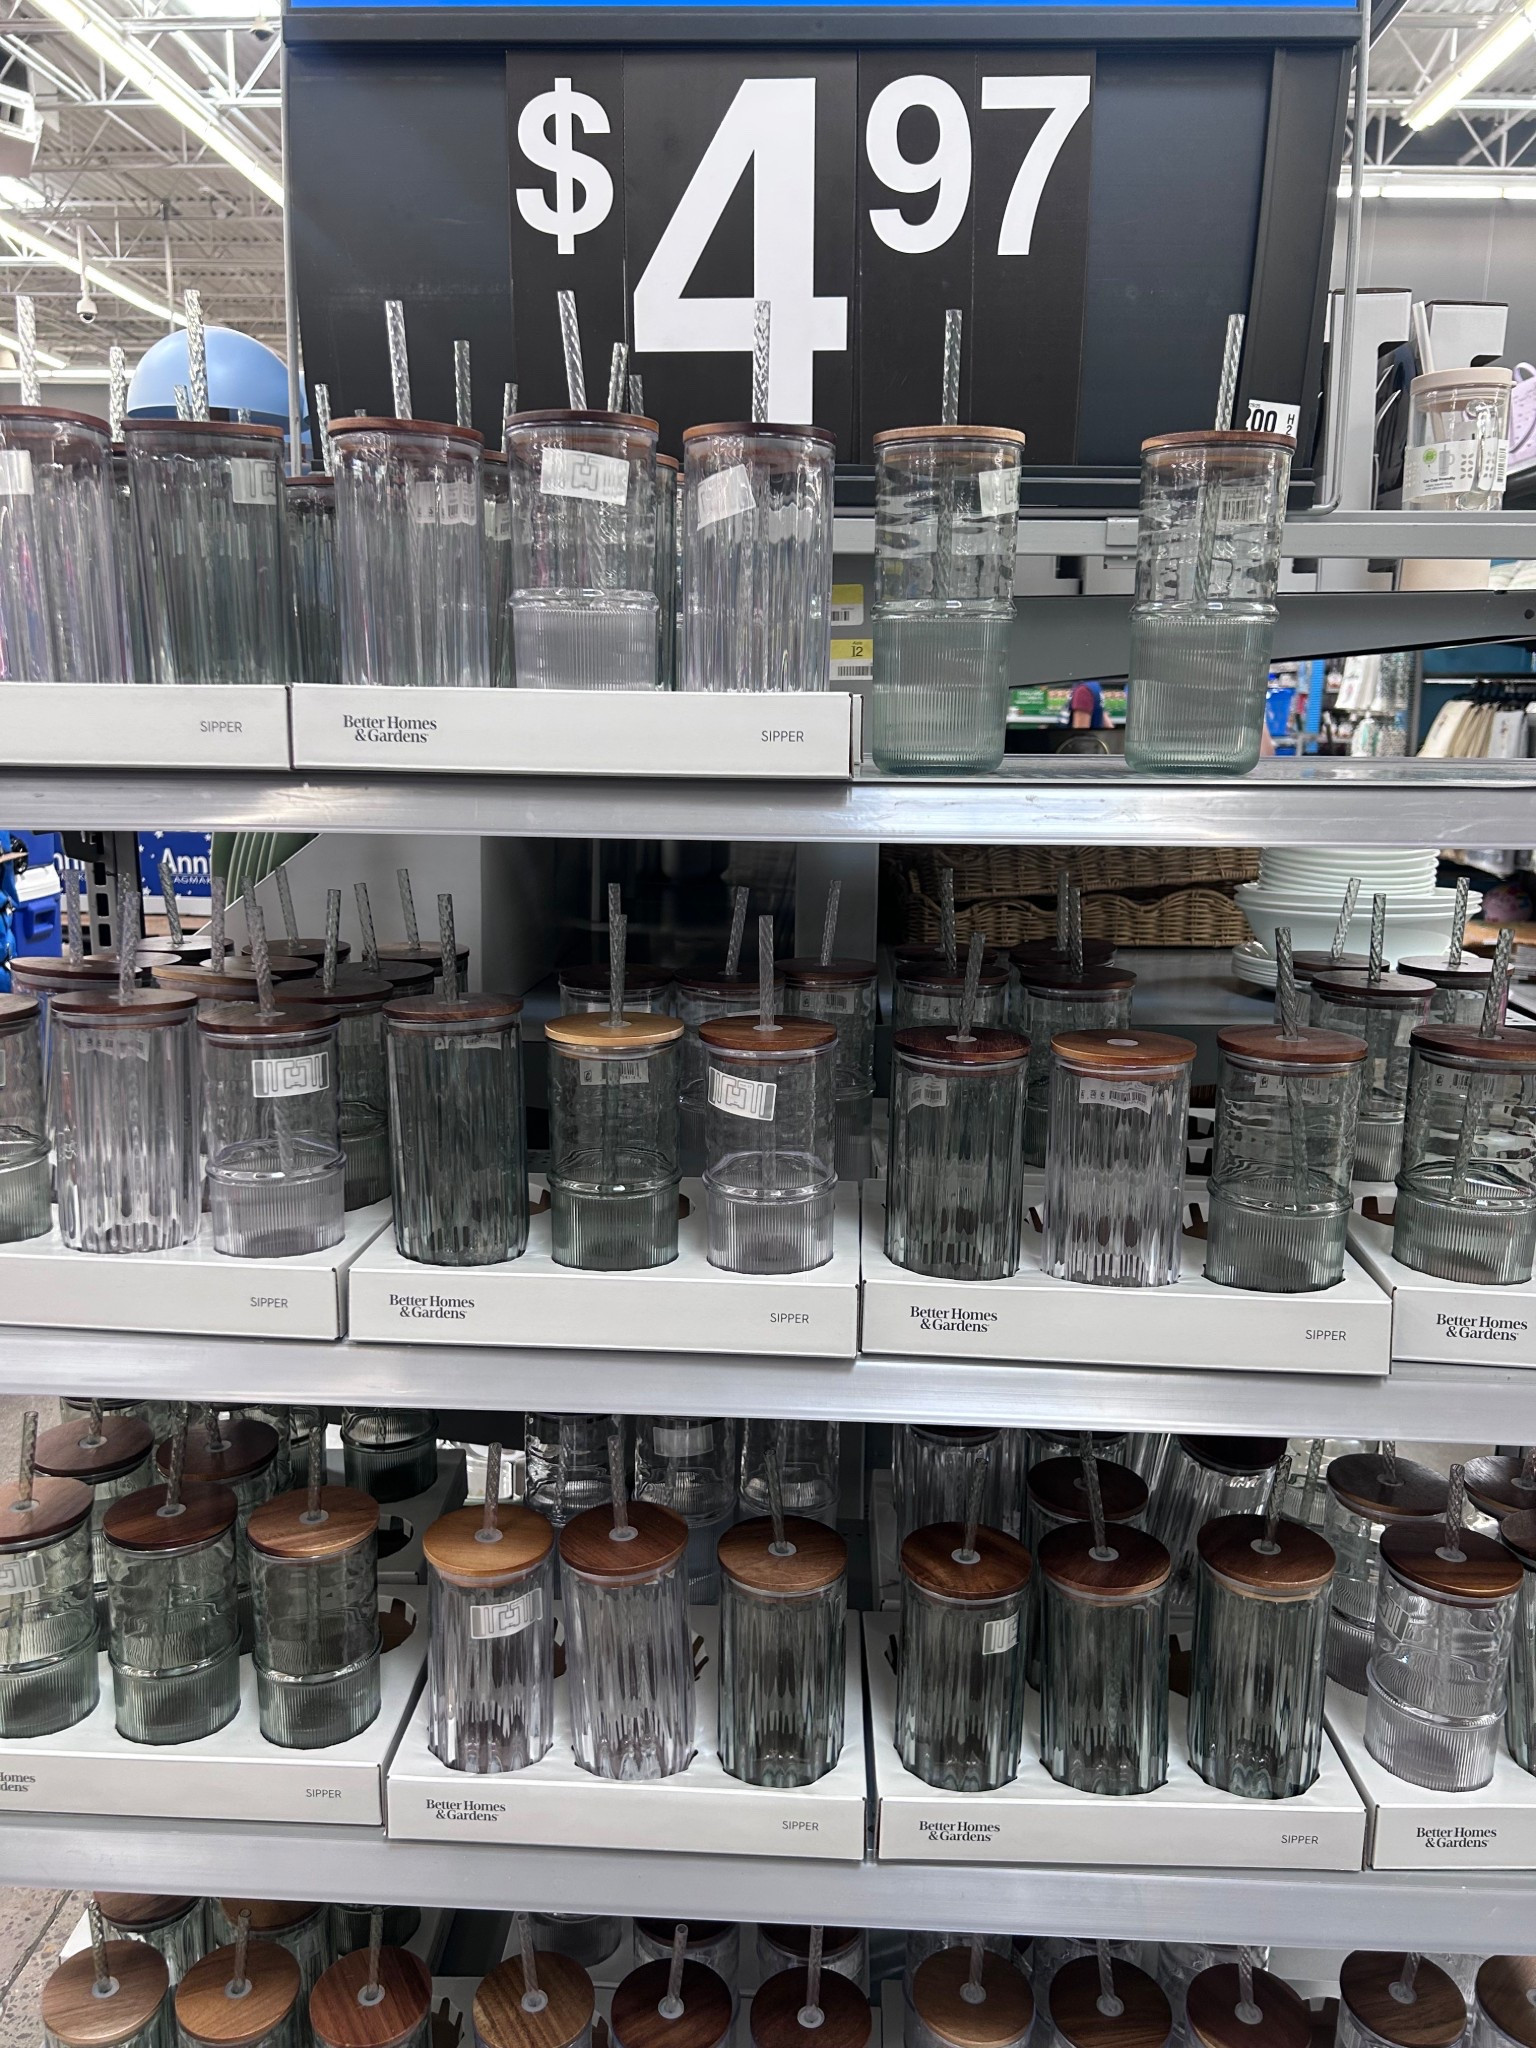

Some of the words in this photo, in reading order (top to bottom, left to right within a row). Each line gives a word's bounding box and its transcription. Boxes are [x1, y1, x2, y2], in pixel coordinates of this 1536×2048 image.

[199, 720, 243, 733] SIPPER
[343, 714, 385, 729] Better
[386, 716, 438, 731] Homes
[760, 730, 805, 742] SIPPER
[161, 848, 211, 875] Ann
[249, 1296, 289, 1309] SIPPER
[389, 1294, 428, 1307] Better
[429, 1295, 475, 1309] Homes
[769, 1312, 810, 1324] SIPPER
[910, 1306, 950, 1320] Better
[951, 1307, 998, 1322] Homes
[1436, 1313, 1478, 1328] Better
[1479, 1315, 1528, 1331] Homes
[1304, 1329, 1347, 1341] SIPPER
[305, 1788, 342, 1799] SIPPER
[426, 1799, 462, 1811] Better
[463, 1800, 507, 1812] Homes
[781, 1820, 819, 1831] SIPPER
[919, 1820, 956, 1832] Better
[957, 1821, 1001, 1833] Homes
[1416, 1826, 1453, 1838] Better
[1454, 1826, 1498, 1838] Homes
[1280, 1834, 1319, 1845] SIPPER
